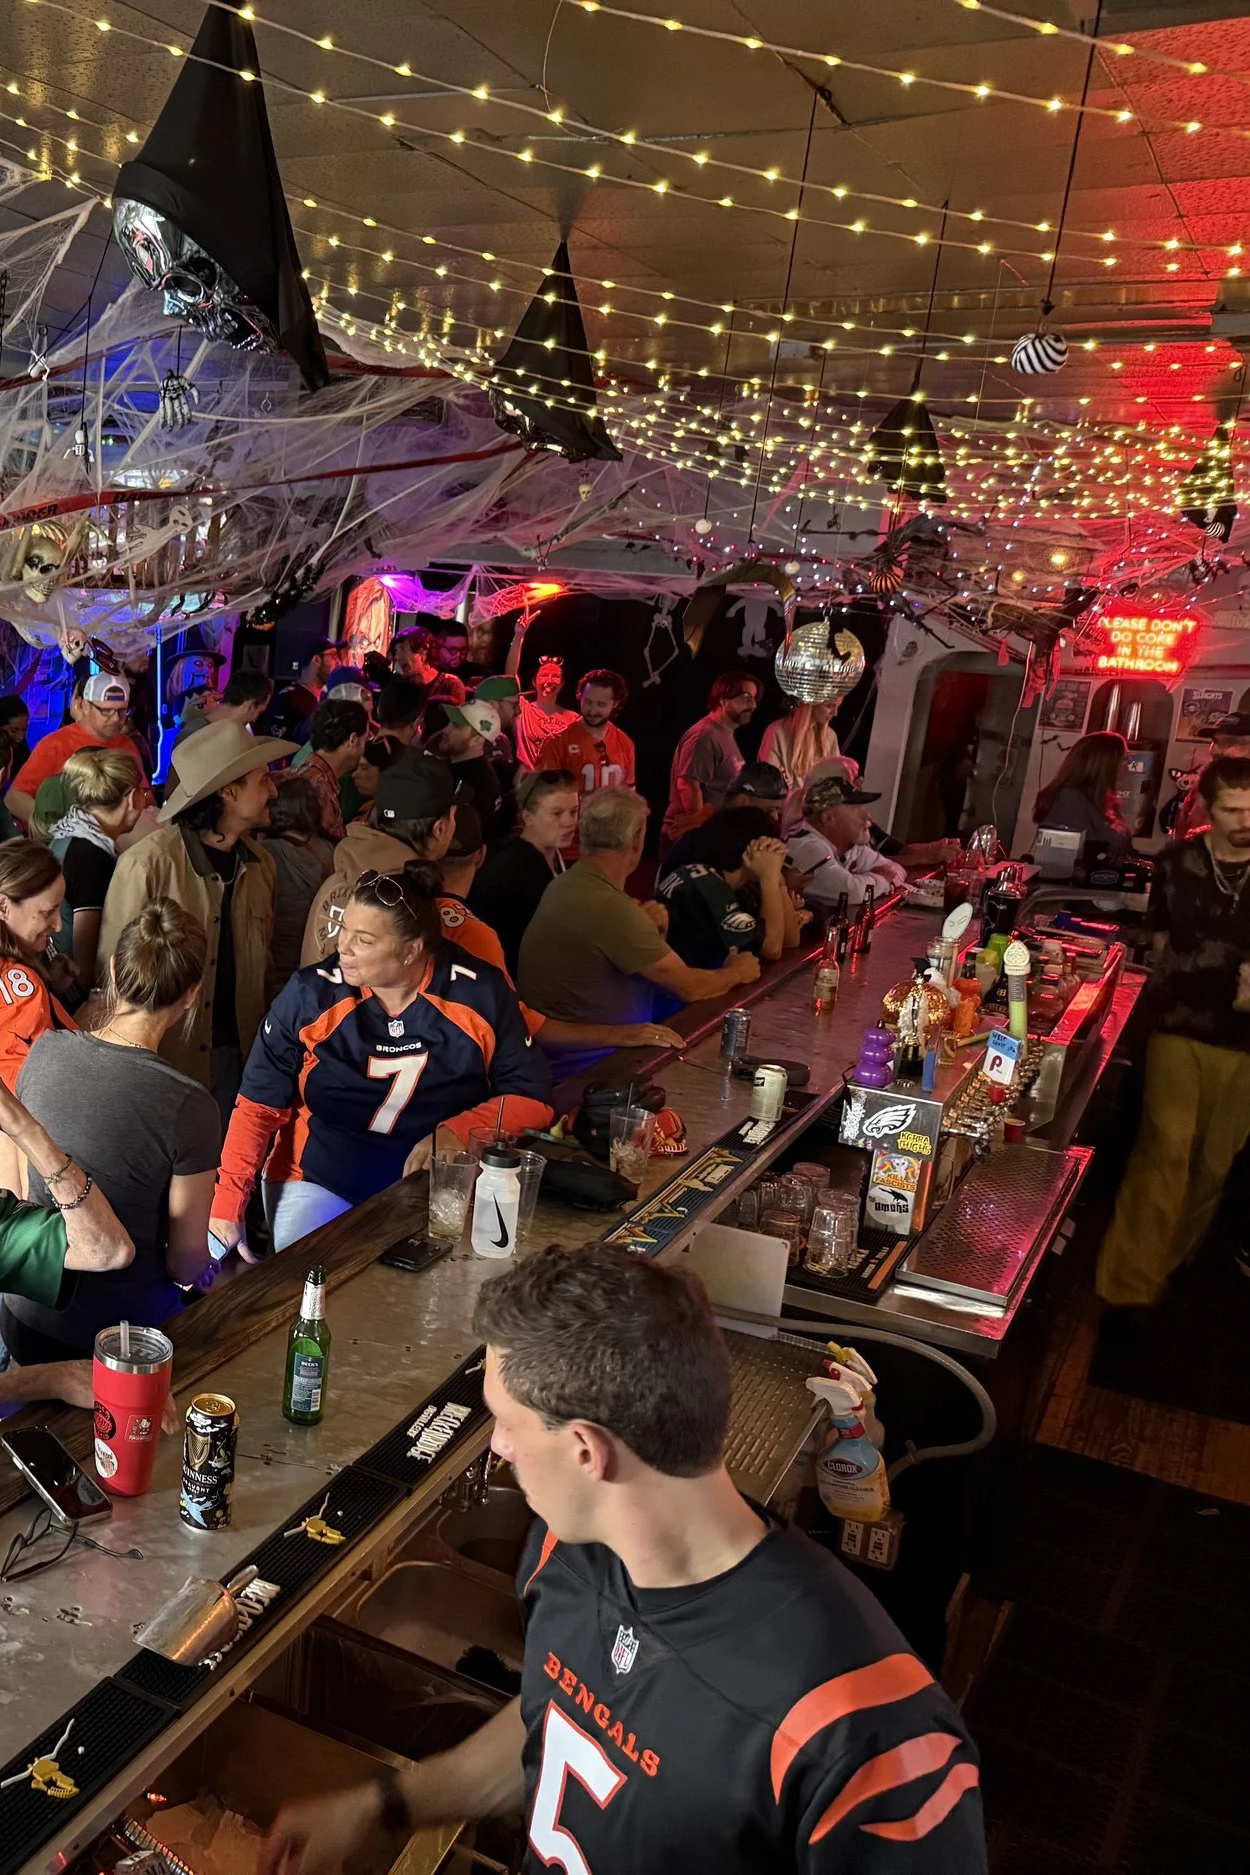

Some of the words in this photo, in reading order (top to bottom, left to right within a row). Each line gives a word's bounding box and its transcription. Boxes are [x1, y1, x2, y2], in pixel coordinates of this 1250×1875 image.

[1097, 616, 1148, 631] PLEASE
[1151, 618, 1197, 633] DON'T
[1111, 631, 1132, 642] DO
[1137, 632, 1176, 645] COKE
[1118, 645, 1131, 656] IN
[1138, 646, 1165, 658] THE
[1098, 656, 1179, 673] BATHROOM
[376, 1042, 422, 1053] BRONCOS
[367, 1051, 429, 1135] 7
[874, 1175, 917, 1192] FASCISTS
[827, 1460, 858, 1474] CLOROX
[543, 1652, 662, 1777] BENGALS
